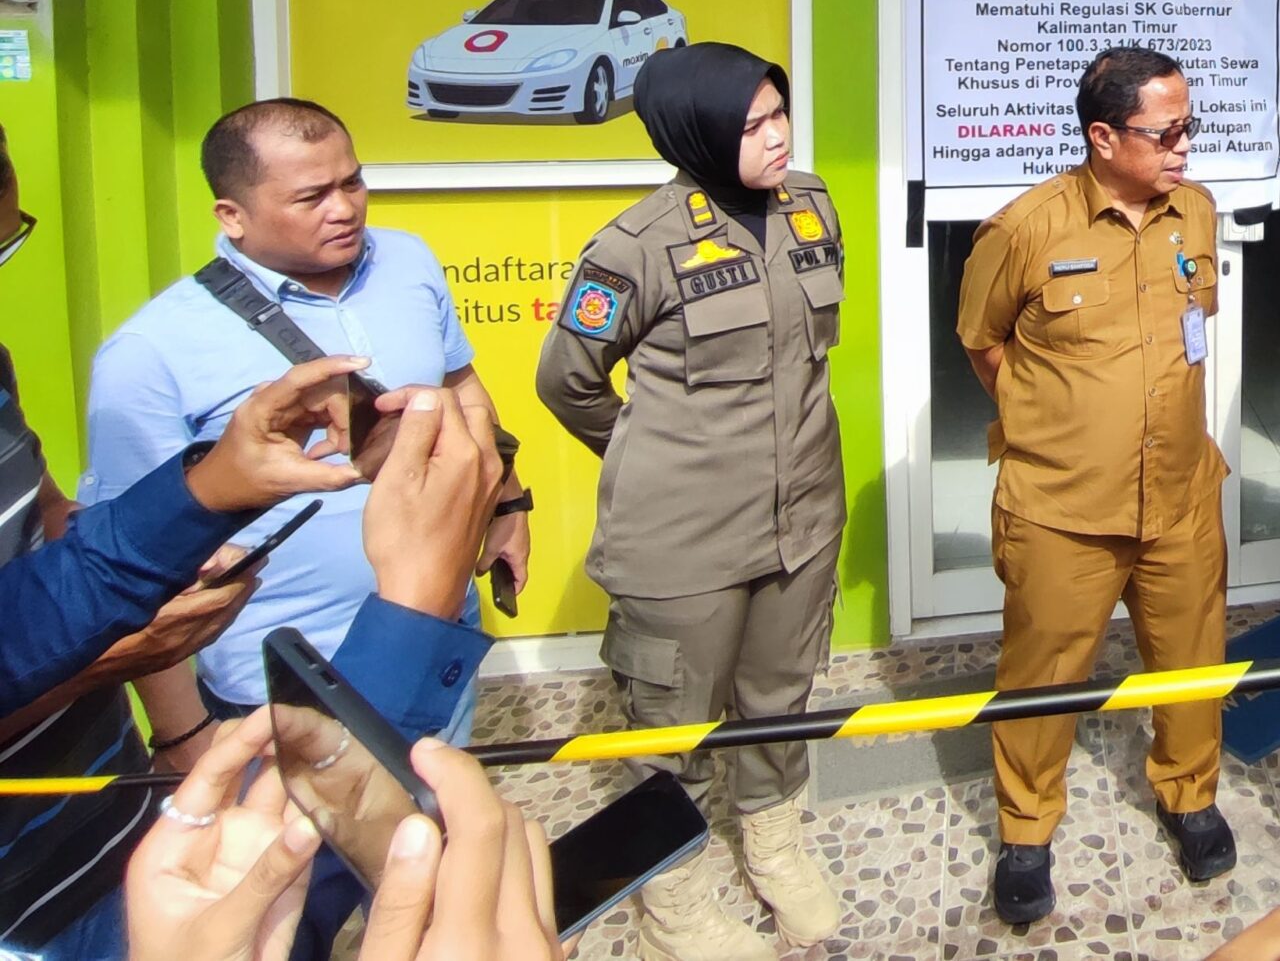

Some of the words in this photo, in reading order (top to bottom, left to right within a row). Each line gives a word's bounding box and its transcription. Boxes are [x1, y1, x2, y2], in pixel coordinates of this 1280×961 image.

[975, 2, 1055, 16] Mematuhi
[1060, 2, 1129, 19] Regulasi
[1134, 1, 1157, 16] SK
[1161, 1, 1233, 17] Gubernur
[1037, 20, 1127, 34] Kalimantan
[1131, 19, 1178, 34] Timur
[997, 39, 1053, 53] Nomor
[944, 58, 1010, 75] Tentang
[1015, 57, 1090, 73] Penetapa
[1176, 56, 1217, 71] kutan
[1220, 56, 1259, 70] Sewa
[957, 76, 1020, 90] Khusus
[1025, 75, 1040, 89] di
[1045, 74, 1081, 88] Prov
[1208, 73, 1249, 87] Timur
[936, 103, 1000, 118] Seluruh
[1003, 102, 1075, 116] Aktivitas
[1199, 99, 1247, 114] Lokasi
[1250, 98, 1268, 112] ini
[957, 123, 1056, 139] DILARANG
[1199, 121, 1252, 136] utupan
[932, 145, 991, 162] Hingga
[995, 143, 1054, 160] adanya
[1190, 139, 1222, 154] suai
[1225, 139, 1273, 153] Aturan
[793, 248, 821, 269] POL
[443, 256, 575, 284] ndaftara
[690, 264, 749, 294] GUSTI
